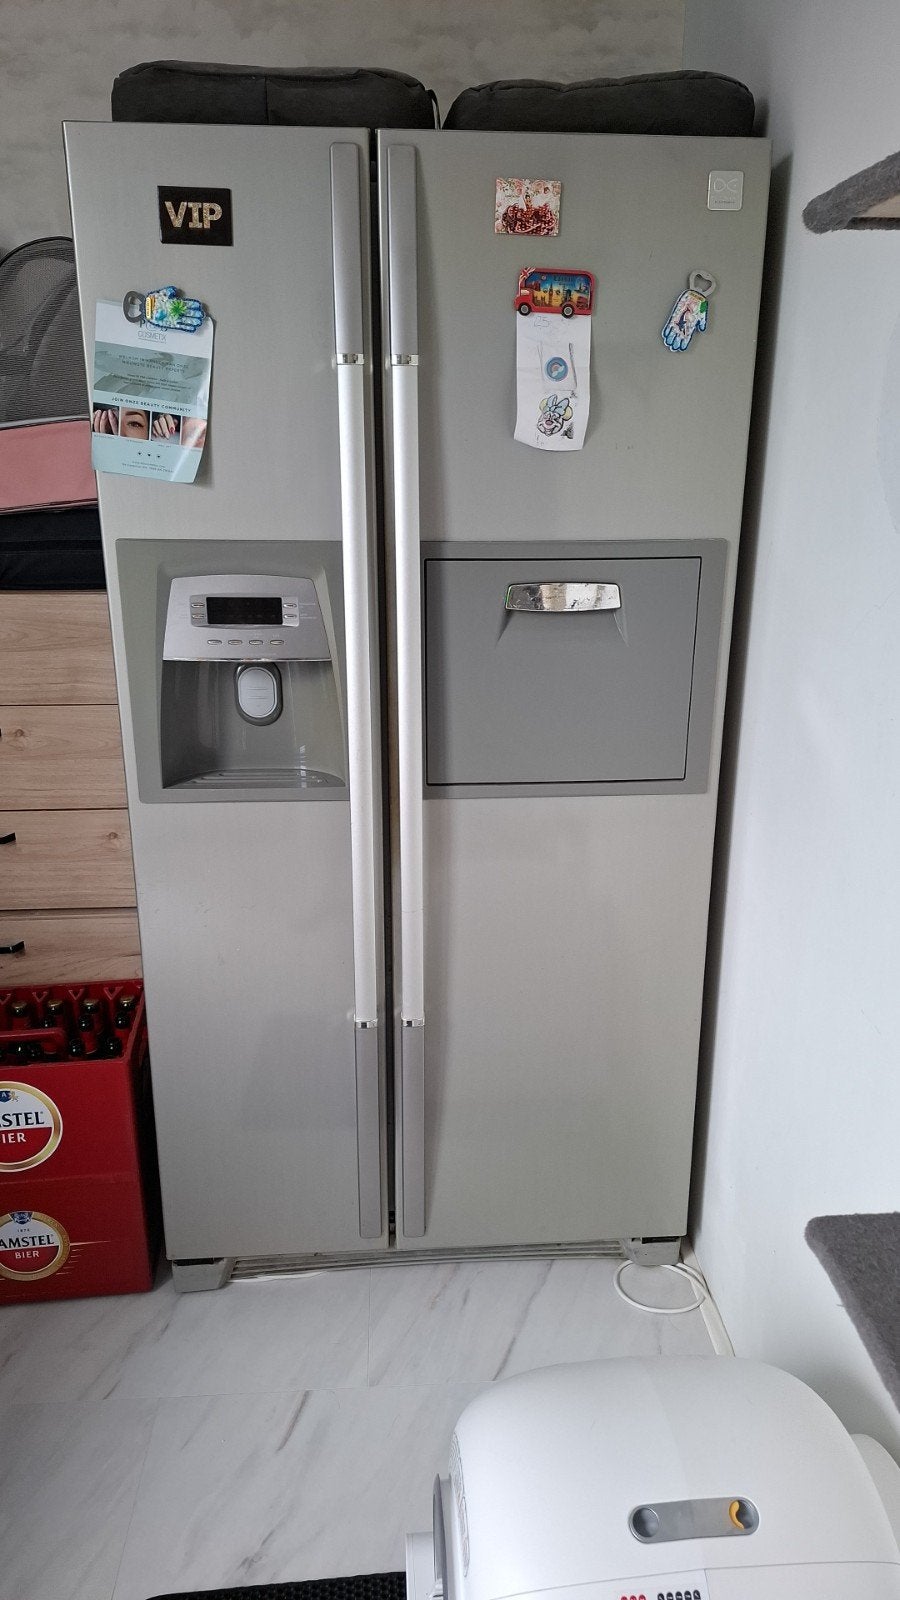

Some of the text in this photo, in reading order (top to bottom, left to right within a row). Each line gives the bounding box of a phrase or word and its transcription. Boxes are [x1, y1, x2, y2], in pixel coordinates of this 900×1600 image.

[164, 200, 223, 229] VIP
[161, 404, 191, 412] COMMUNITY
[0, 1111, 44, 1127] STEL
[0, 1235, 54, 1249] AMSTEL
[15, 1250, 40, 1259] BIER
